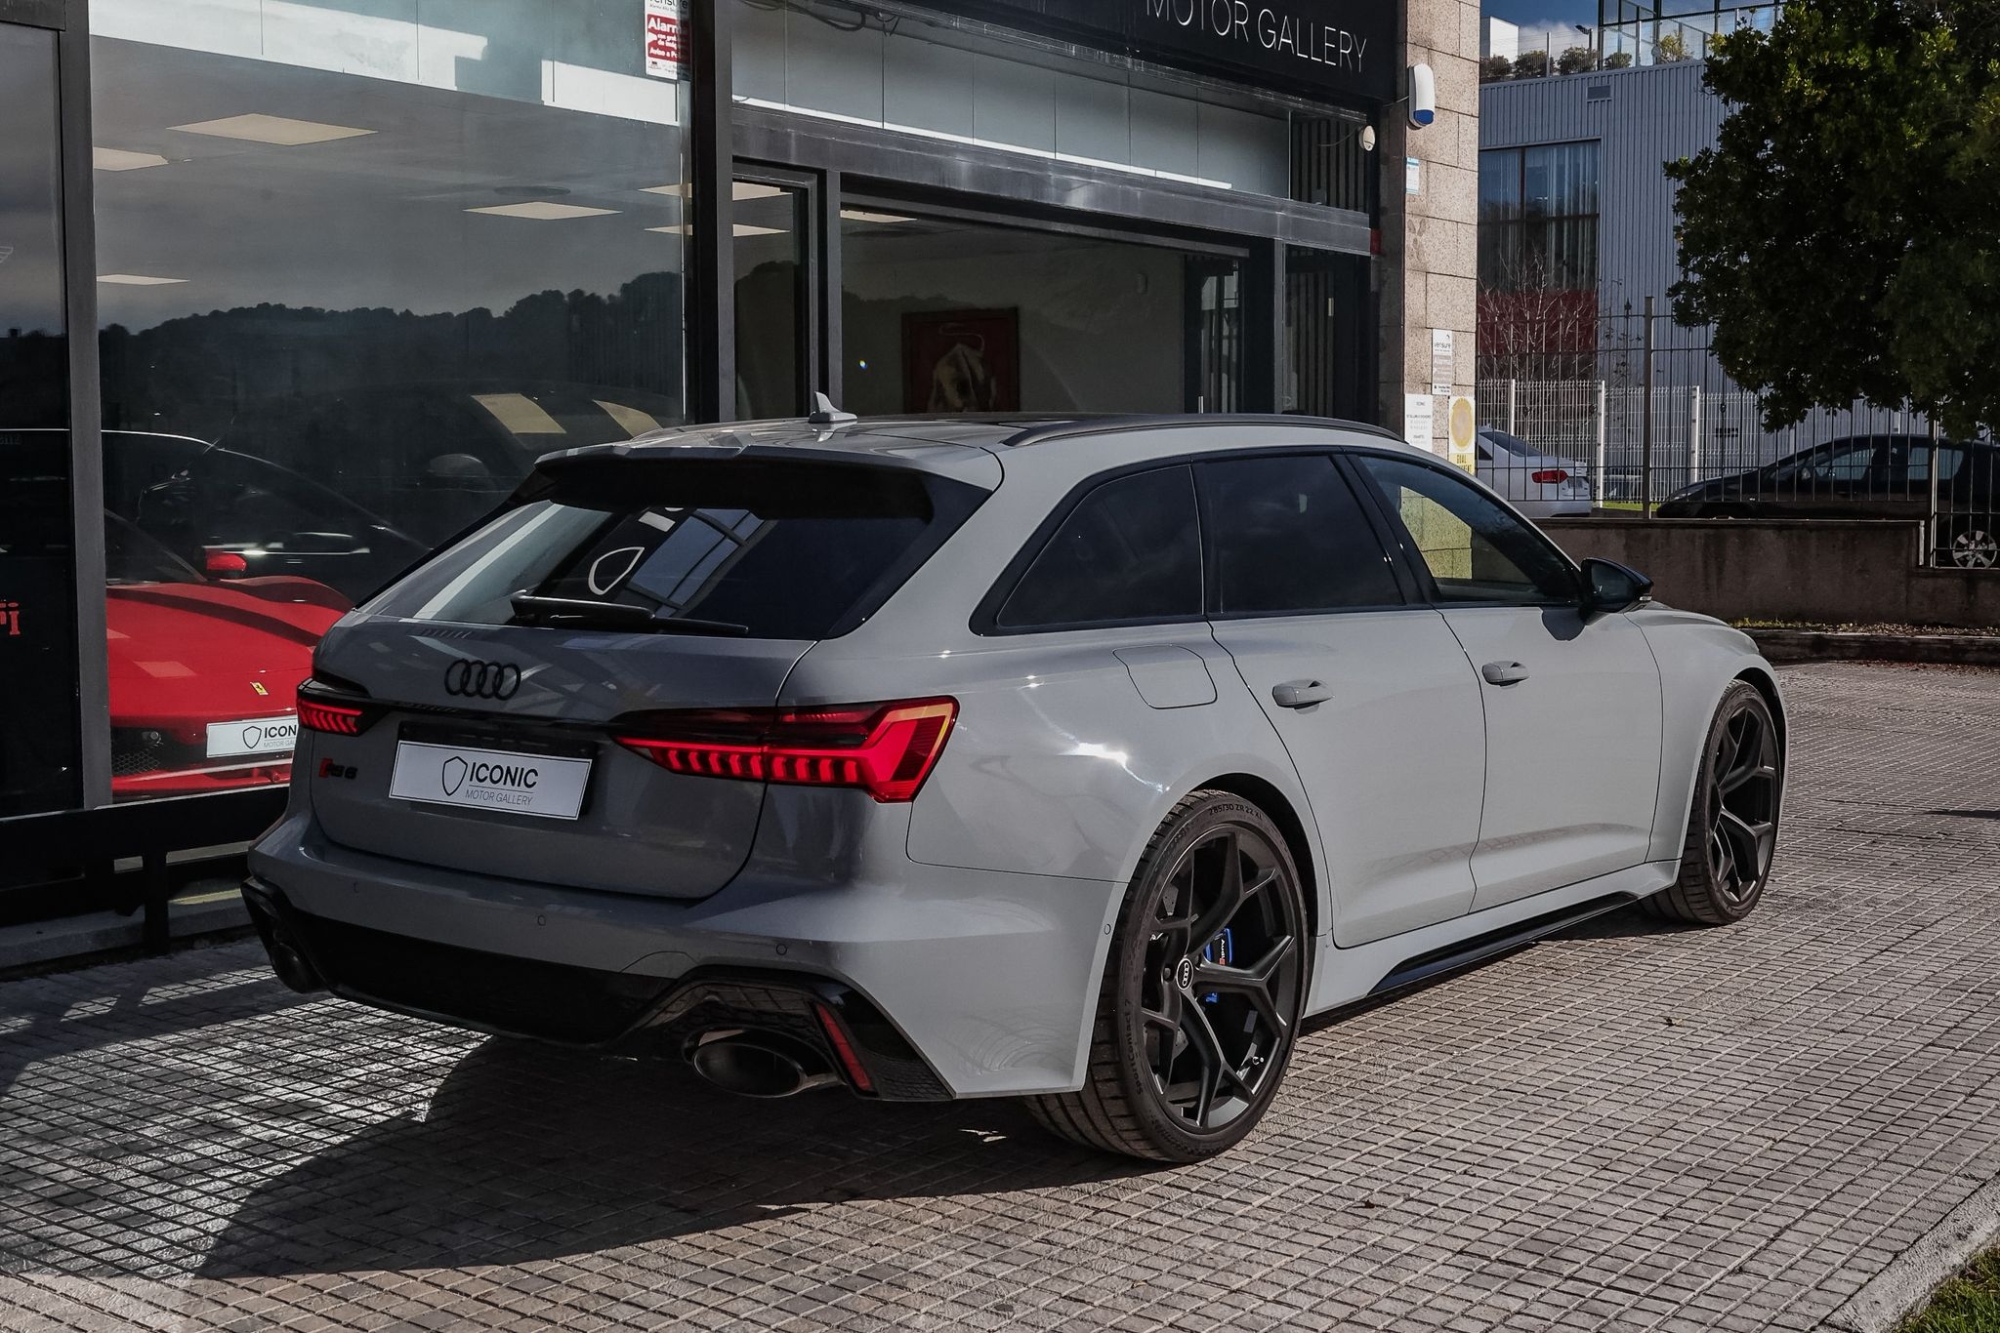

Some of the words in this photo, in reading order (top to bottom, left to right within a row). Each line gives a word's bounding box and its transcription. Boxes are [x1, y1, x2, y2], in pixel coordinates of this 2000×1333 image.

[1257, 8, 1367, 73] GALLERY
[264, 724, 297, 739] ICON
[469, 761, 539, 789] ICONIC
[465, 789, 495, 803] MOTOR
[496, 791, 533, 807] GALLERY
